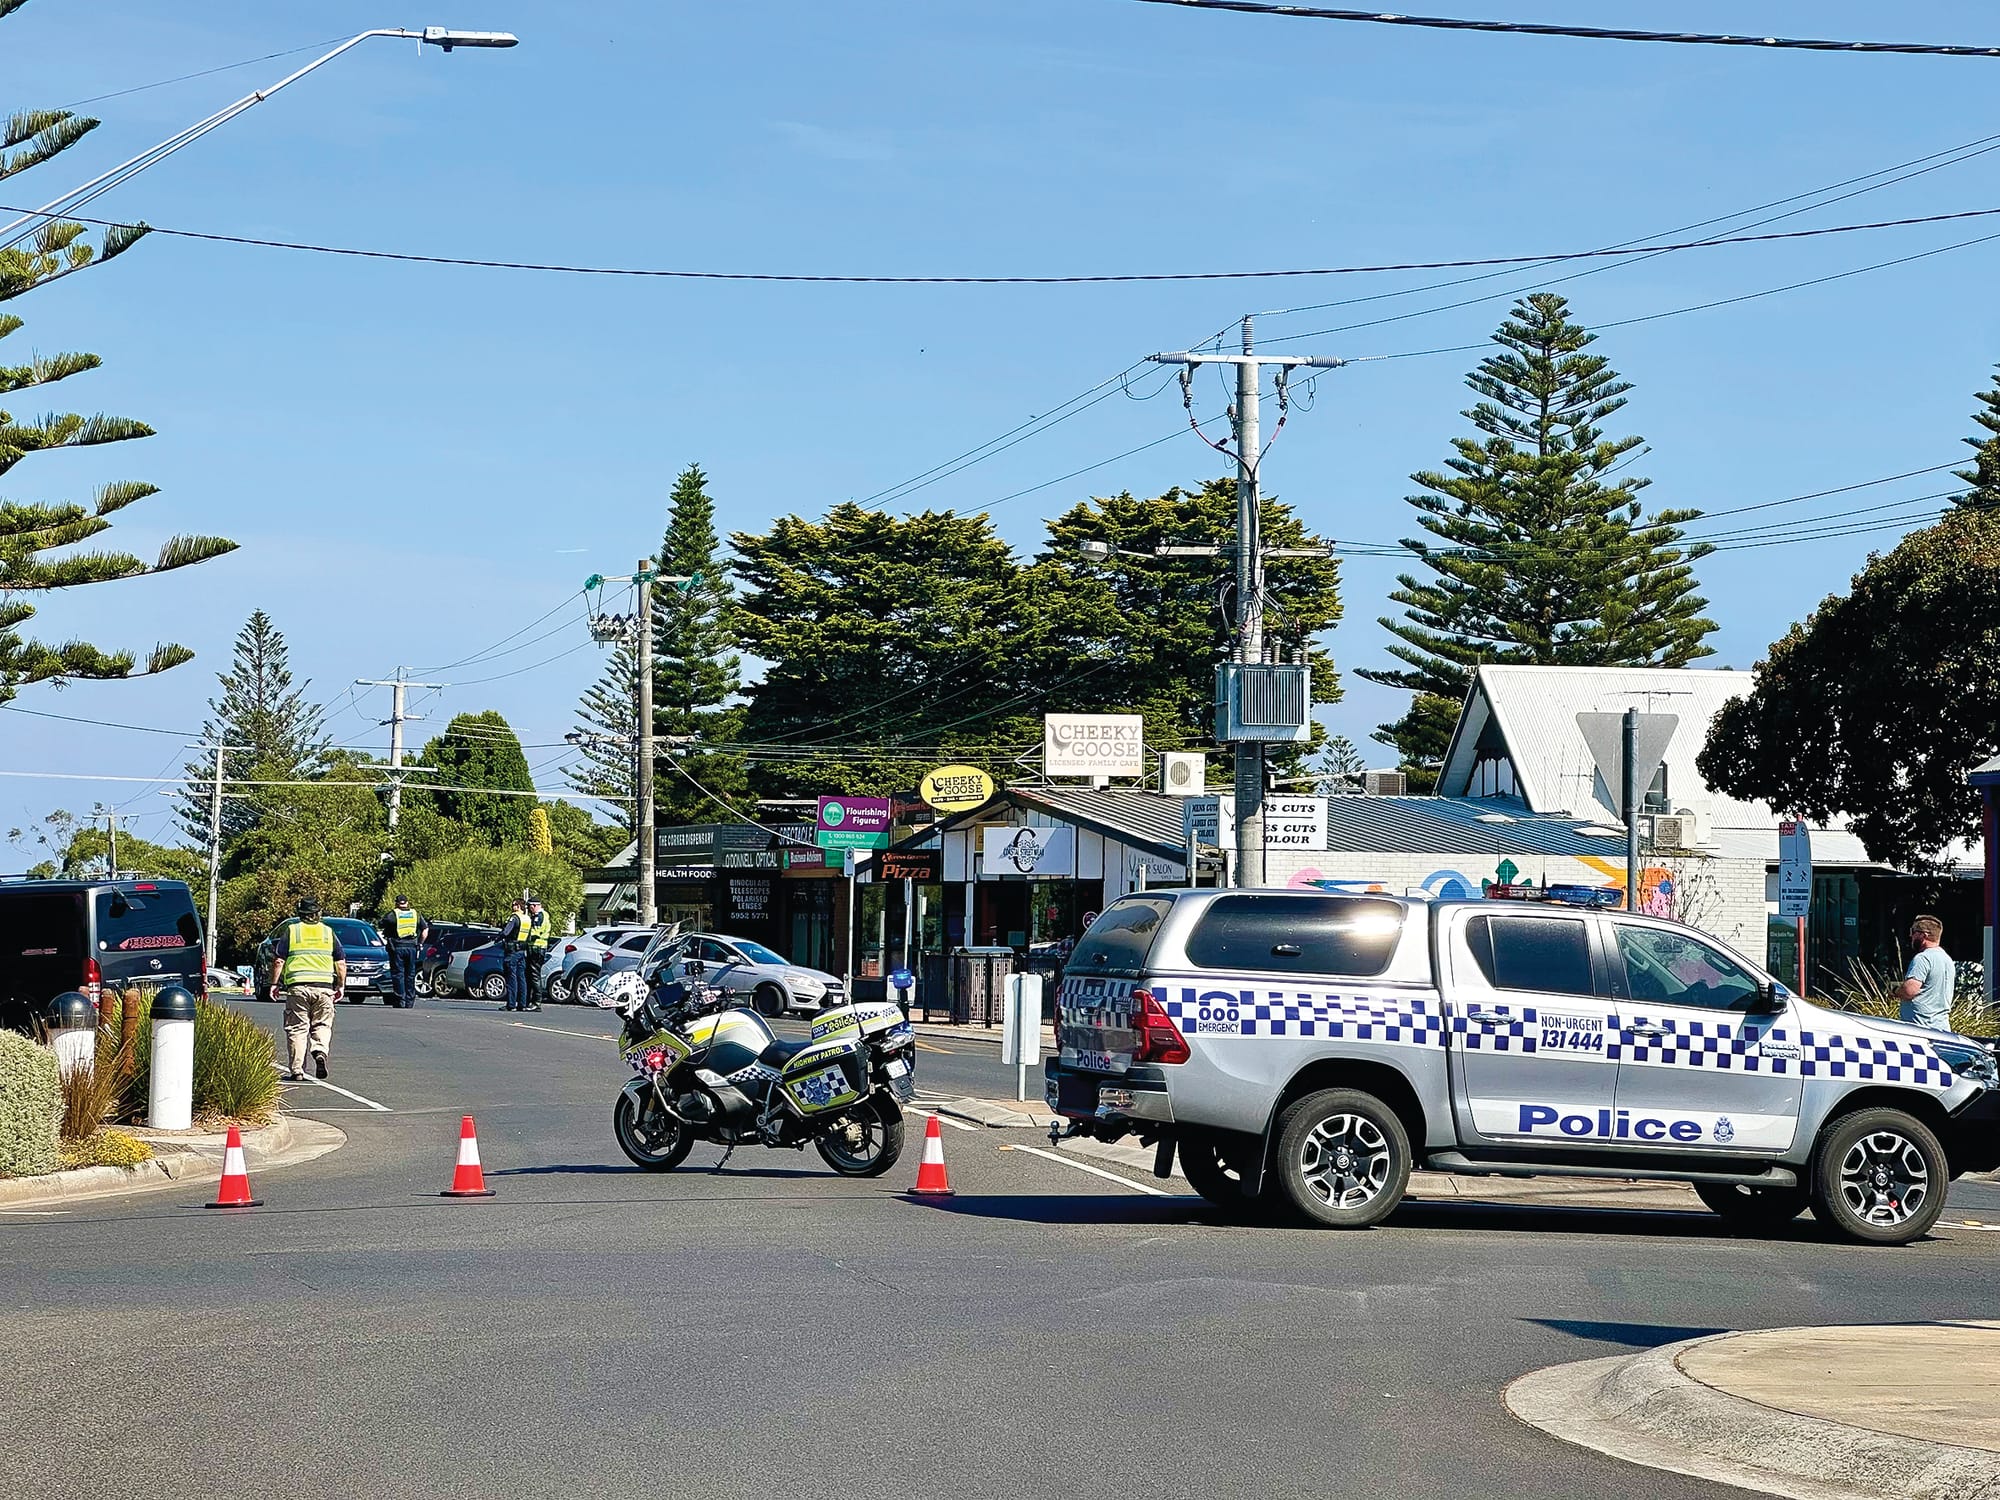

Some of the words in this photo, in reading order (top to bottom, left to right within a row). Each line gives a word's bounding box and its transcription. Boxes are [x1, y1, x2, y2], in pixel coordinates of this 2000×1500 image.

[1059, 724, 1140, 740] CHEEKY
[1072, 741, 1139, 757] GOOSE
[1049, 759, 1086, 767] LICENSED
[936, 775, 983, 787] CHEEKY
[944, 784, 983, 795] GOOSE
[846, 807, 888, 821] Flourishing
[1281, 804, 1316, 813] CUTS
[852, 816, 880, 826] Figures
[1283, 824, 1317, 833] CUTS
[655, 869, 688, 878] HEALTH
[688, 869, 718, 879] FOODS
[881, 864, 931, 879] Pizza
[1153, 863, 1173, 875] SALON
[730, 887, 771, 895] TELESCOPES
[737, 903, 763, 911] LENSES
[130, 935, 185, 948] HONDA
[1199, 1007, 1240, 1022] 000
[828, 1015, 857, 1033] Police
[1198, 1022, 1240, 1034] EMERGENCY
[1541, 1016, 1604, 1032] NON-URGENT
[1541, 1029, 1566, 1049] 131
[1568, 1031, 1604, 1051] 444
[626, 1045, 659, 1064] Police
[793, 1054, 820, 1069] HIGHWAY
[820, 1046, 845, 1059] PATROL
[1077, 1049, 1111, 1070] Police
[1518, 1104, 1703, 1142] Police
